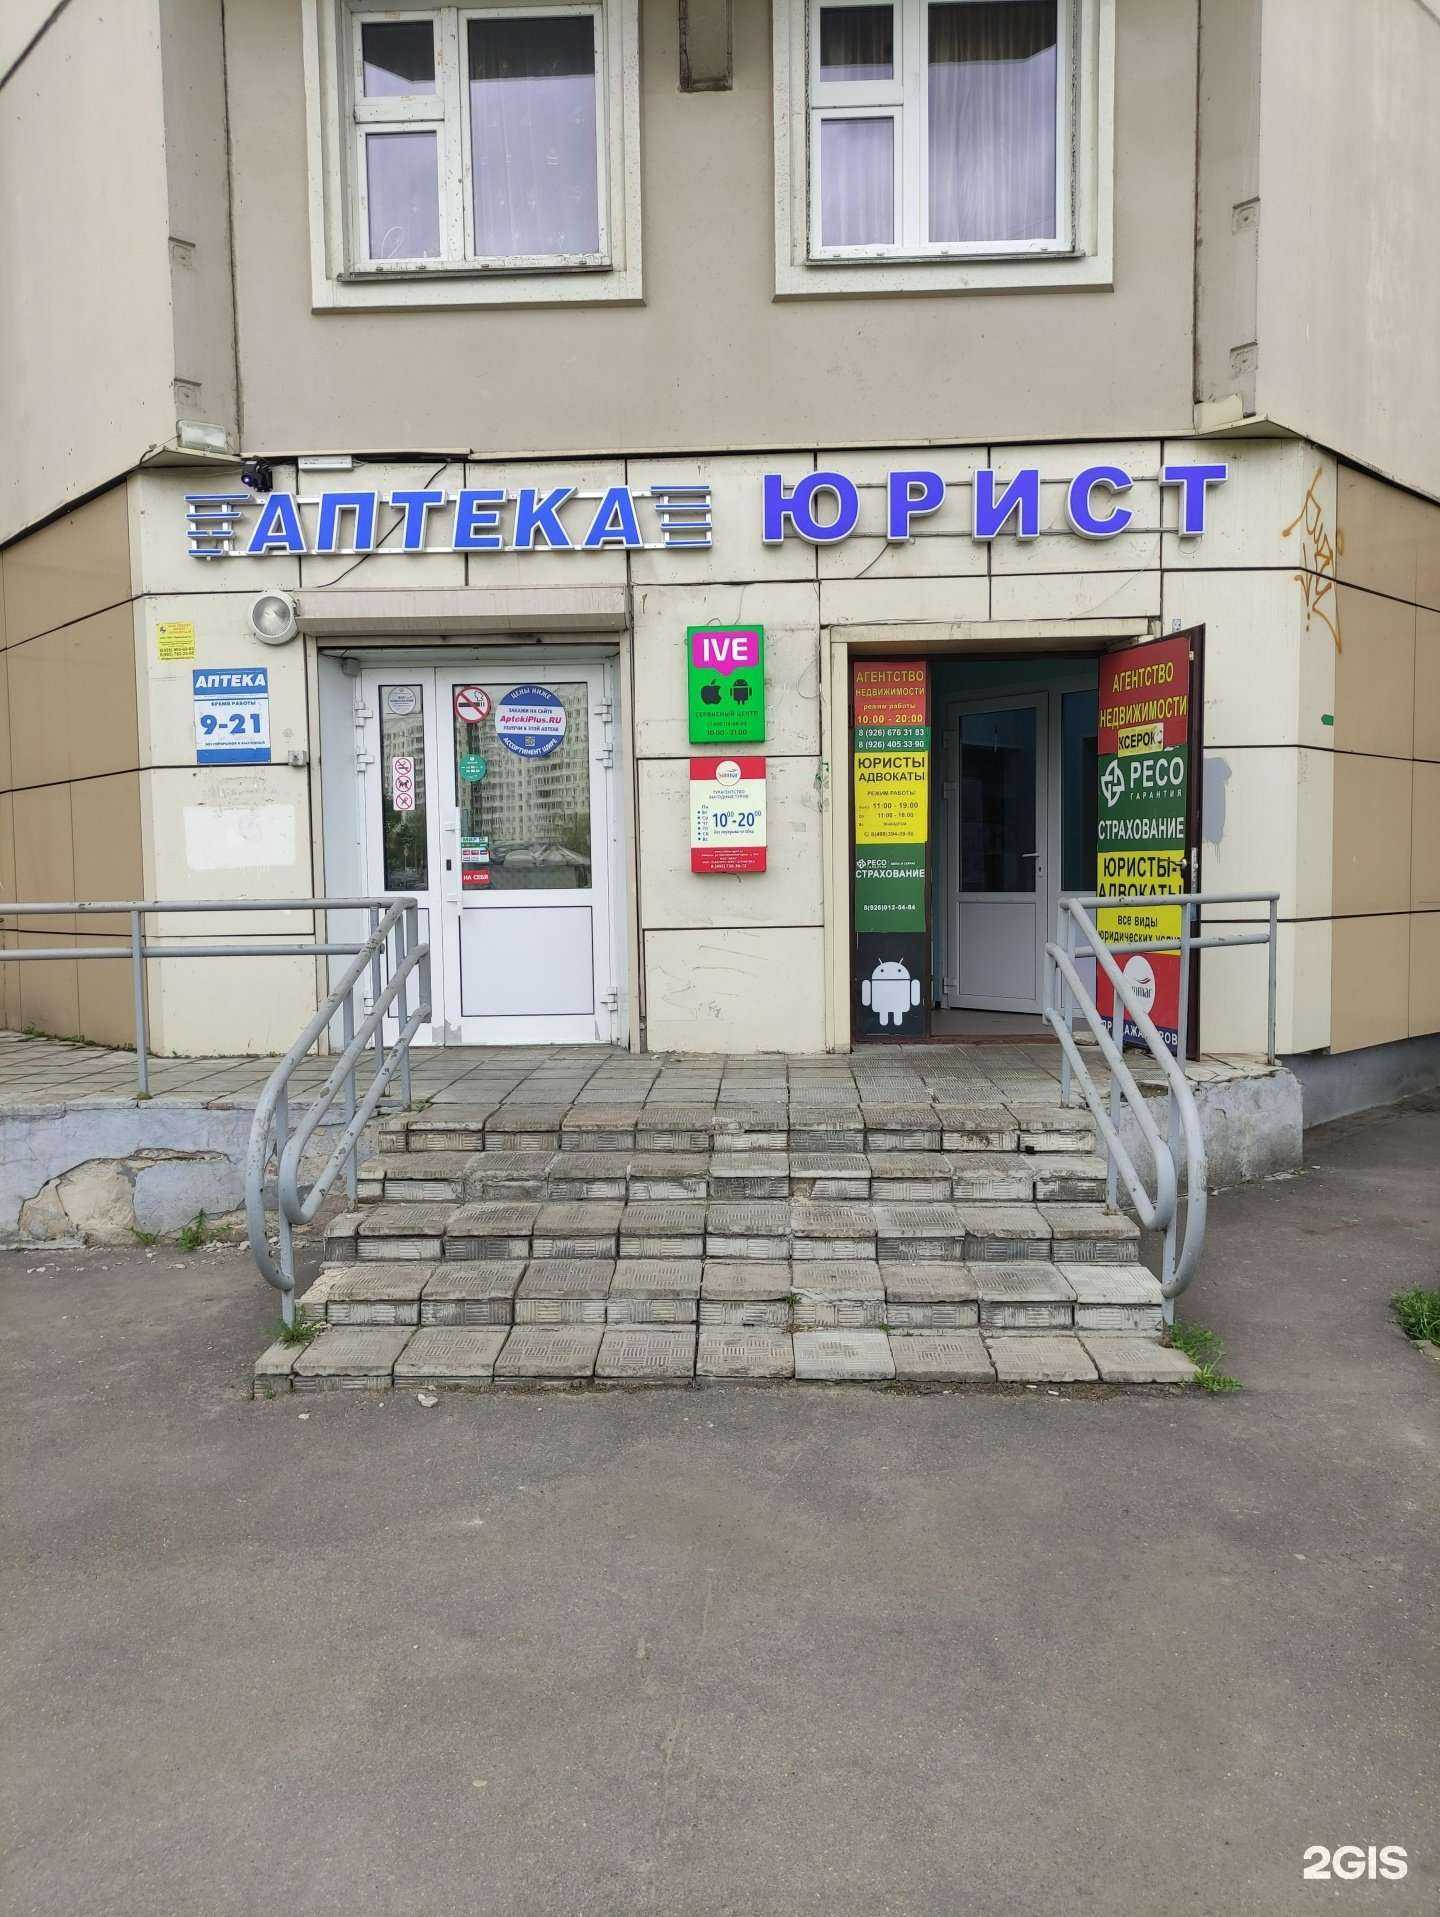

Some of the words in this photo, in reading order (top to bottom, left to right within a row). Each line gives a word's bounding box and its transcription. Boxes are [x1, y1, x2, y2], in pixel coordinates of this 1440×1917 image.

[761, 463, 1229, 546] ЮРИСТ
[247, 487, 645, 555] АПТЕКА
[703, 637, 748, 661] IVE
[195, 673, 266, 689] АПТЕКА
[856, 670, 924, 683] АГЕНТСТВО
[1112, 661, 1174, 693] АГЕНТСТВО
[855, 687, 925, 697] НЕДВИЖИМОСТИ
[499, 715, 562, 724] AptekiPlus.RU
[858, 714, 885, 724] 10:00
[895, 714, 923, 723] 20:00
[1100, 695, 1187, 730] НЕДВИЖИМОСТИ
[200, 713, 261, 735] 9-21
[858, 757, 925, 769] ЮРИСТЫ
[859, 772, 925, 783] АДВОКАТЫ
[1130, 756, 1184, 789] РЕСО
[1130, 788, 1182, 800] ГАРАНТИЯ
[1098, 817, 1185, 840] СТРАХОВАНИЕ
[855, 868, 925, 879] СТРАХОВАНИЕ
[1104, 857, 1170, 878] ЮРИСТЫ
[1134, 916, 1158, 929] виды
